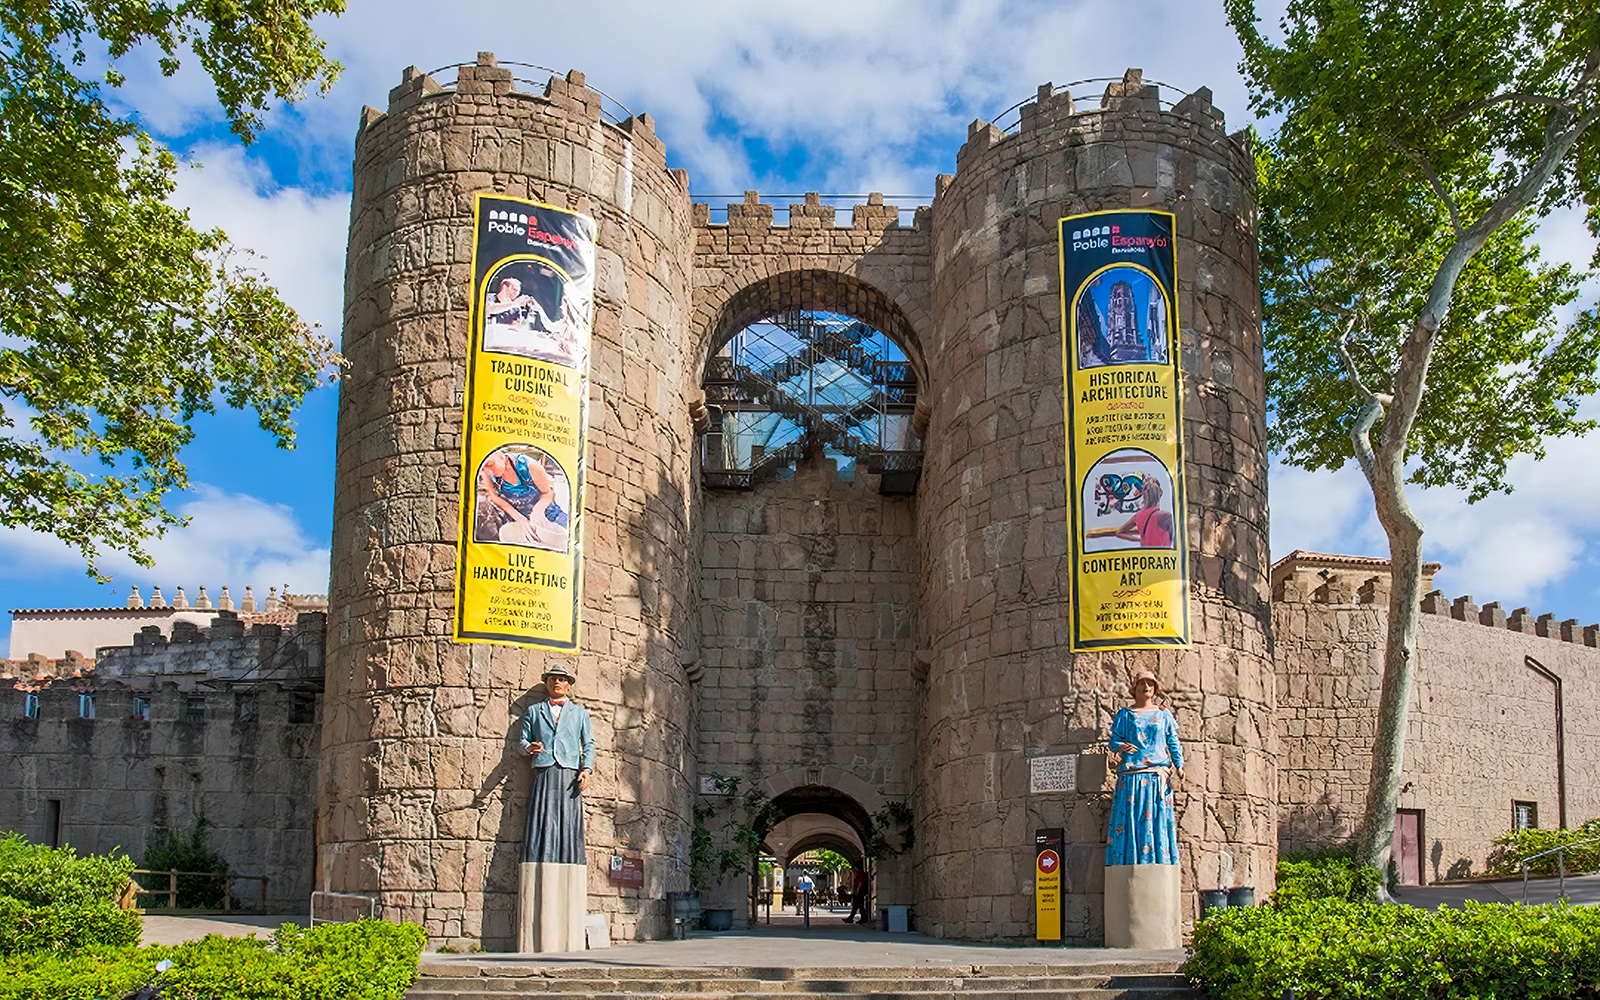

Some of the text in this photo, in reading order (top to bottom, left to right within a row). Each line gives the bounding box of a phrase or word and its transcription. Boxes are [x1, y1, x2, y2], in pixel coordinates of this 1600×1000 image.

[527, 226, 579, 250] Espany
[1073, 235, 1167, 252] Poble Espanyol
[491, 360, 569, 387] TRADITIONAL
[1090, 371, 1159, 387] HISTORICAL
[505, 377, 554, 398] CUISINE
[1081, 385, 1168, 403] ARCHITECTURE
[508, 553, 535, 569] LIVE
[1083, 556, 1177, 574] CONTEMPORARY
[473, 566, 568, 589] HANDCRAFTING
[1120, 572, 1143, 587] ART
